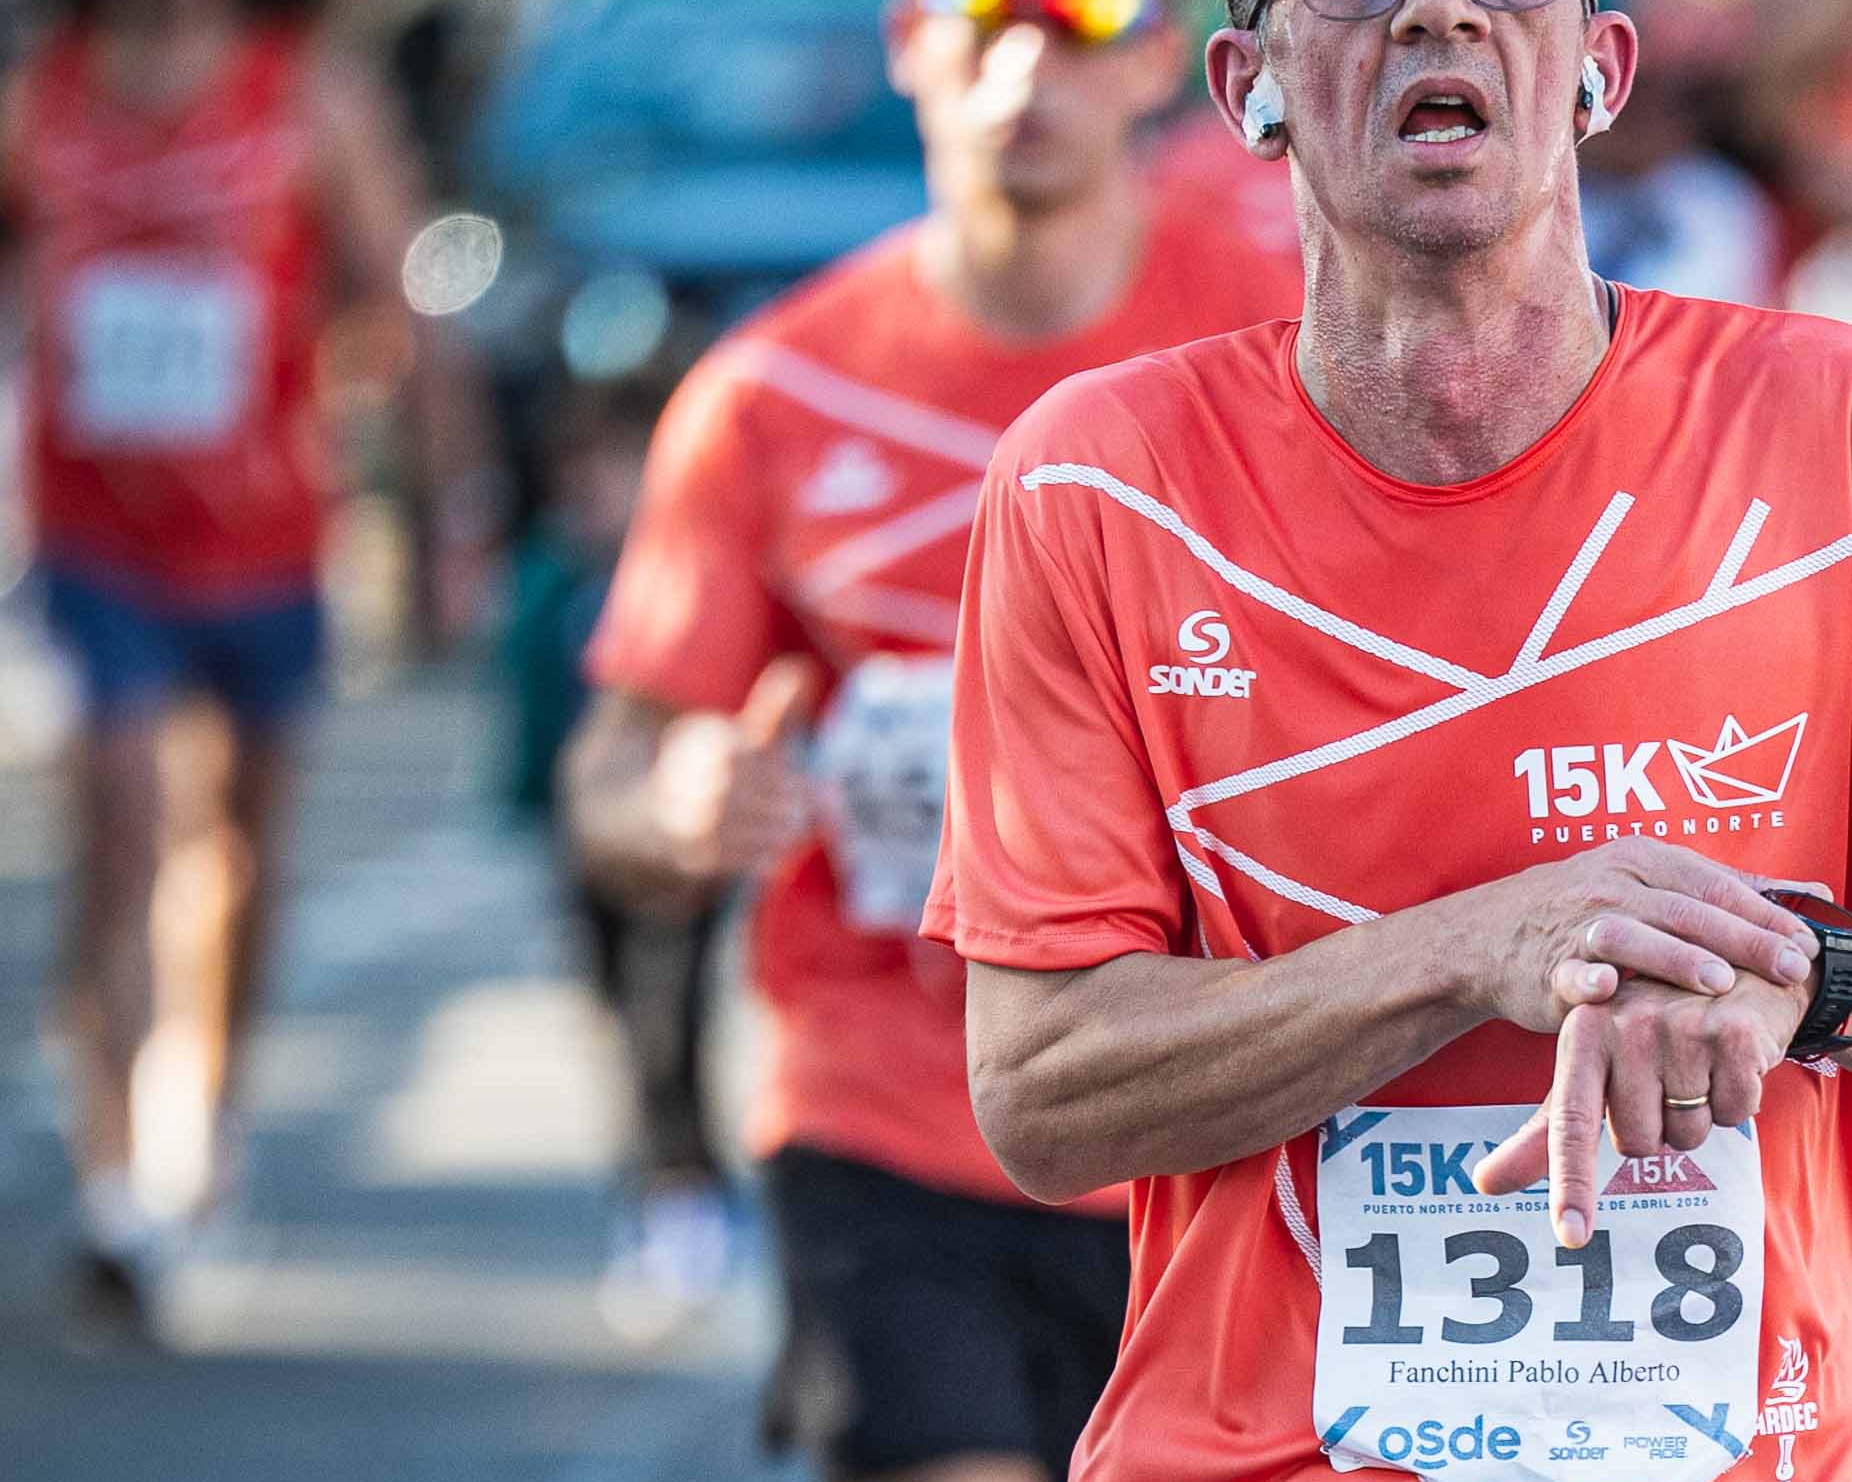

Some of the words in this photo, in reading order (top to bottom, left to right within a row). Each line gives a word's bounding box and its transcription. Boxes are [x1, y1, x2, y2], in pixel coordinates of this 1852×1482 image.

[1513, 741, 1666, 818] 15K
[1531, 822, 1667, 844] PUERTO
[1683, 811, 1784, 835] NORTE
[1361, 1142, 1480, 1197] 15K
[1627, 1155, 1689, 1185] 15K
[1363, 1204, 1415, 1215] PUERTO
[1419, 1204, 1463, 1215] NORTE
[1468, 1202, 1501, 1213] 2026
[1610, 1200, 1626, 1210] DE
[1631, 1198, 1672, 1210] ABRIL
[1676, 1197, 1709, 1208] 2026
[1342, 1224, 1744, 1344] 1318
[1388, 1360, 1498, 1383] Fanchini
[1508, 1360, 1580, 1383] Pablo
[1589, 1360, 1680, 1383] Alberto
[1378, 1414, 1522, 1462] osde
[1623, 1436, 1688, 1449] POWER
